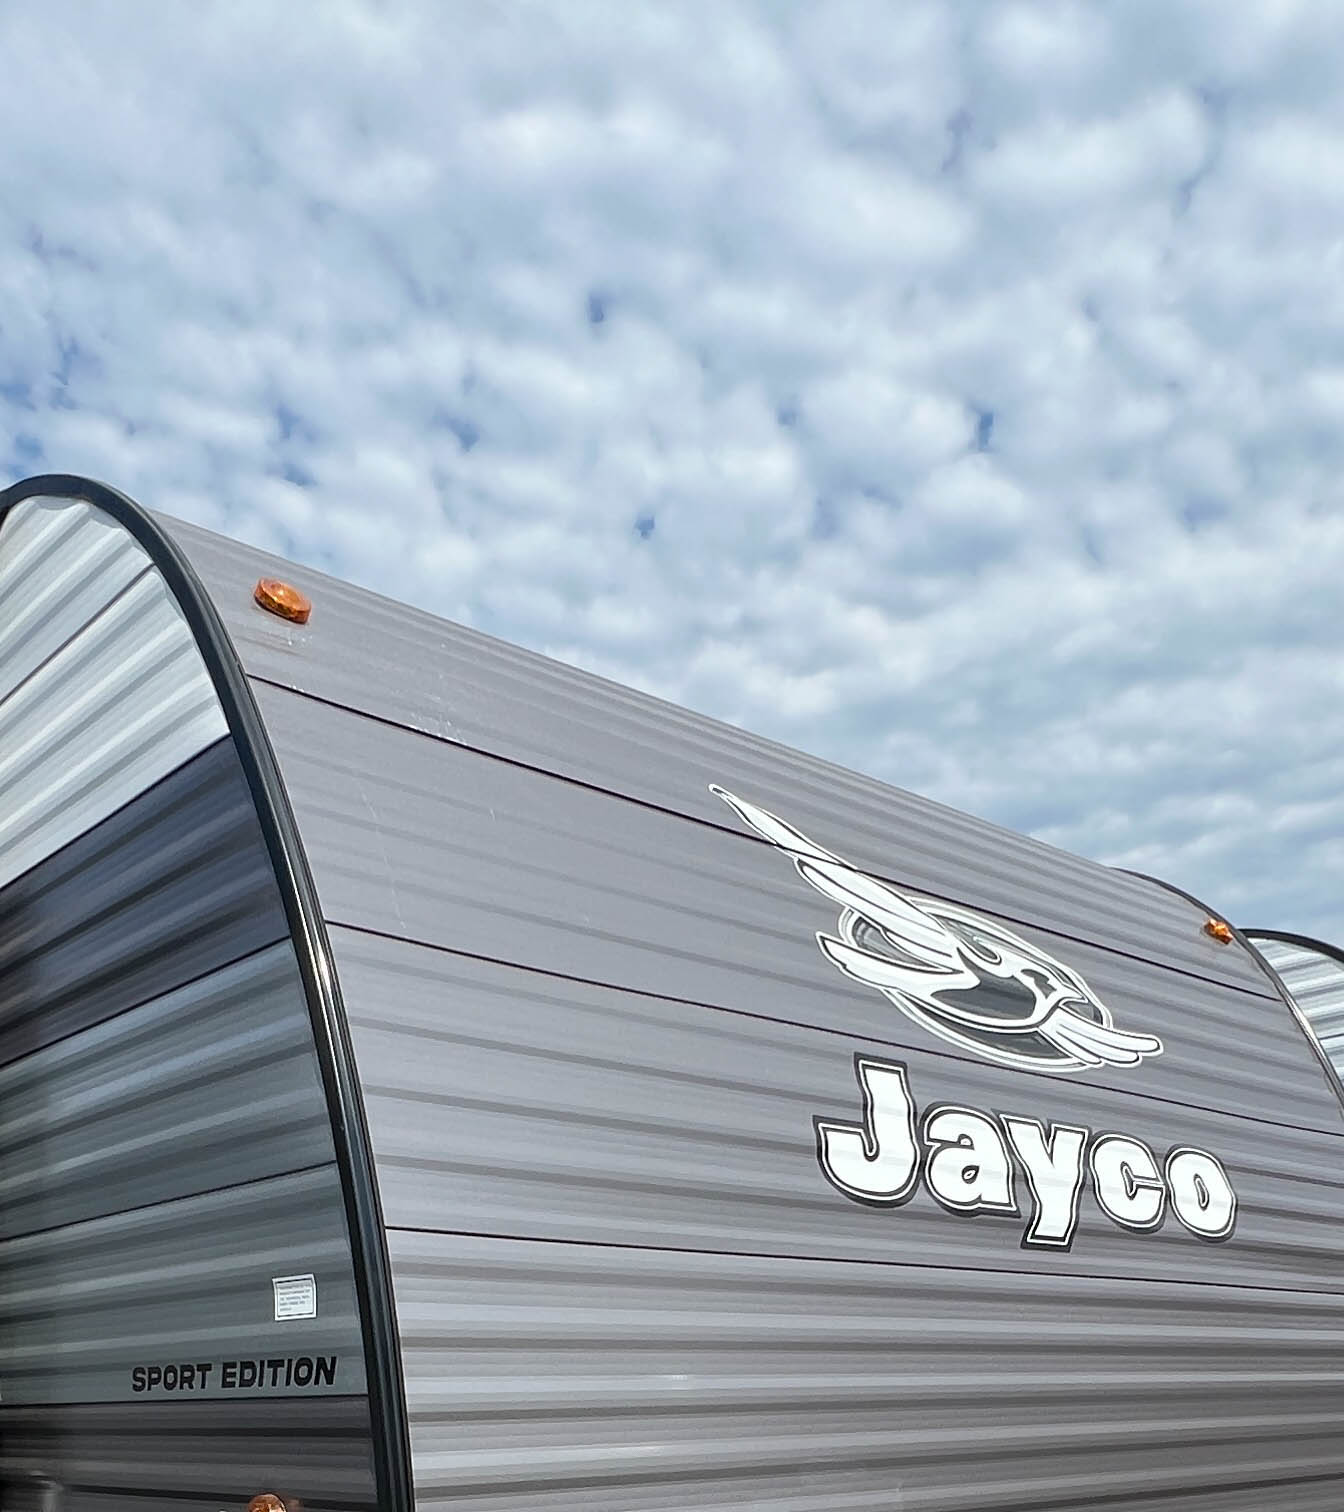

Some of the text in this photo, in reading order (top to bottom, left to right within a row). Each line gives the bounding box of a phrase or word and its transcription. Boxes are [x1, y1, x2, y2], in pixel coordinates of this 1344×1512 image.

[814, 1054, 1237, 1251] Jayco
[132, 1356, 337, 1392] SPORT EDITION
